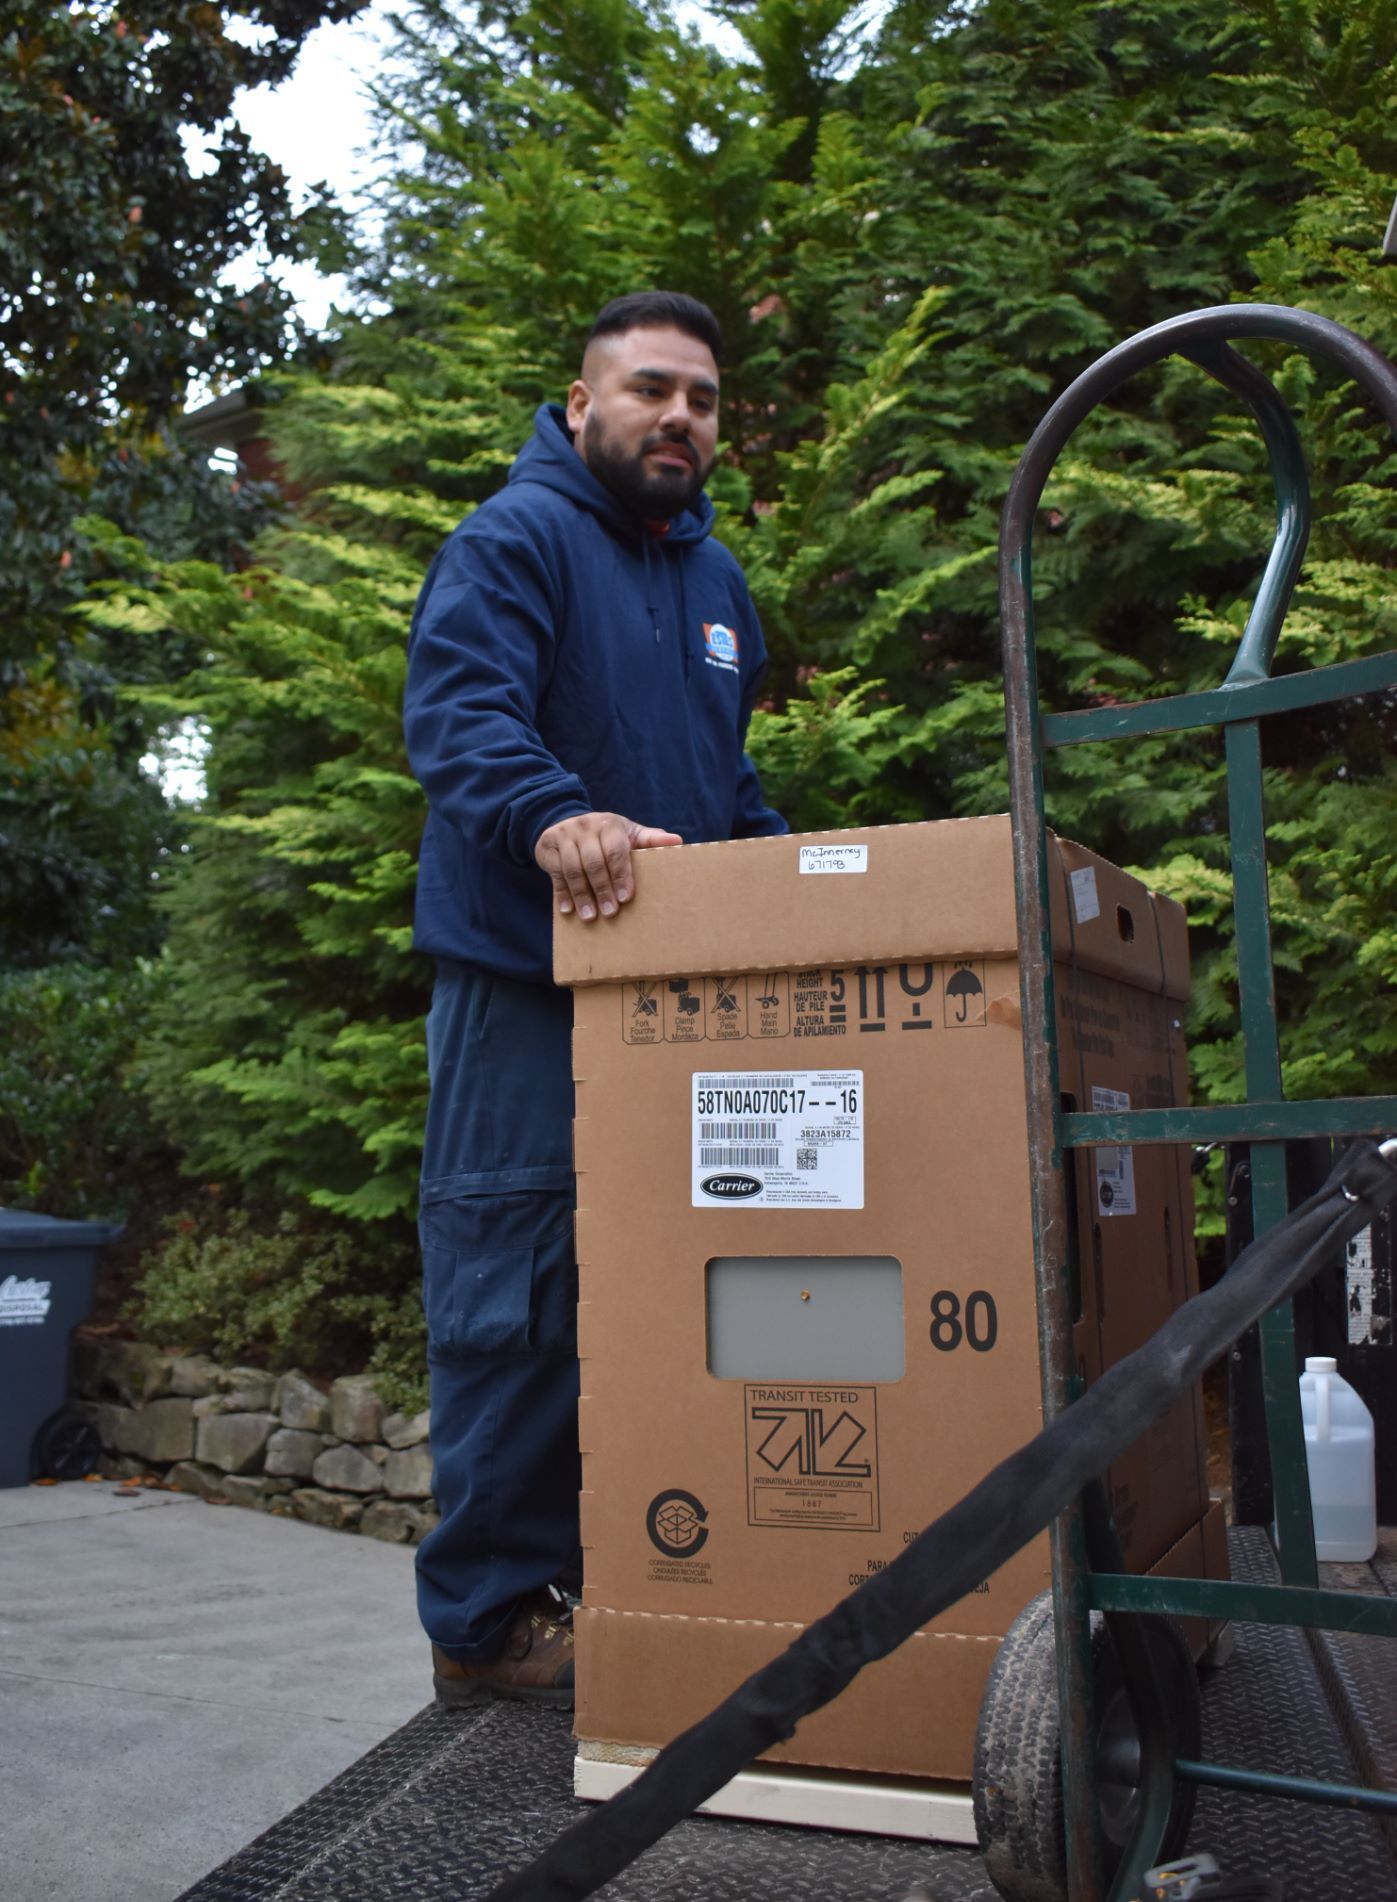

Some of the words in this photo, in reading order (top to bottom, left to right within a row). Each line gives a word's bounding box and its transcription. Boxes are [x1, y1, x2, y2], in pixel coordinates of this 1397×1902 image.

[797, 977, 823, 989] HEIGHT
[830, 969, 845, 1002] 5
[794, 991, 828, 1002] HAUTEUR
[796, 1002, 805, 1012] DE
[809, 1001, 825, 1012] PILE
[796, 1015, 825, 1026] ALTURA
[794, 1027, 802, 1037] DE
[804, 1025, 847, 1037] APILAMIENTO
[800, 1129, 852, 1138] 3823A15872
[709, 1179, 755, 1191] Carrier
[930, 1290, 998, 1352] 80
[750, 1389, 807, 1402] TRANSIT
[808, 1391, 859, 1404] TESTED
